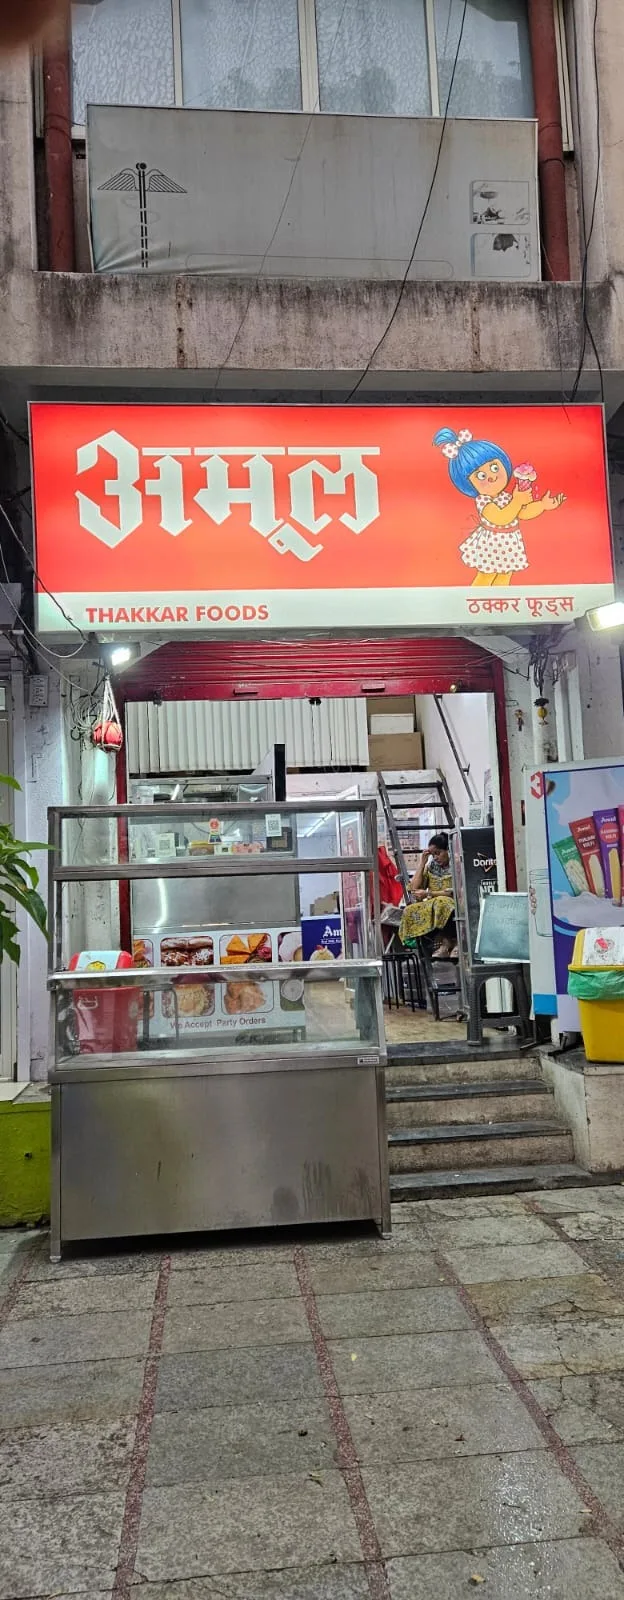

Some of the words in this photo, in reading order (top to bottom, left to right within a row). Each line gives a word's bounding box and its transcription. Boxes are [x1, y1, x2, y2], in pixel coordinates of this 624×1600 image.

[75, 430, 380, 562] अमूल
[86, 607, 189, 623] THAKKAR
[195, 605, 269, 621] FOODS
[466, 598, 521, 613] ठक्कर
[525, 597, 574, 617] फूड्स
[323, 925, 342, 938] Am
[184, 1020, 212, 1030] Accept
[216, 1018, 237, 1028] Party
[239, 1016, 267, 1026] Orders
